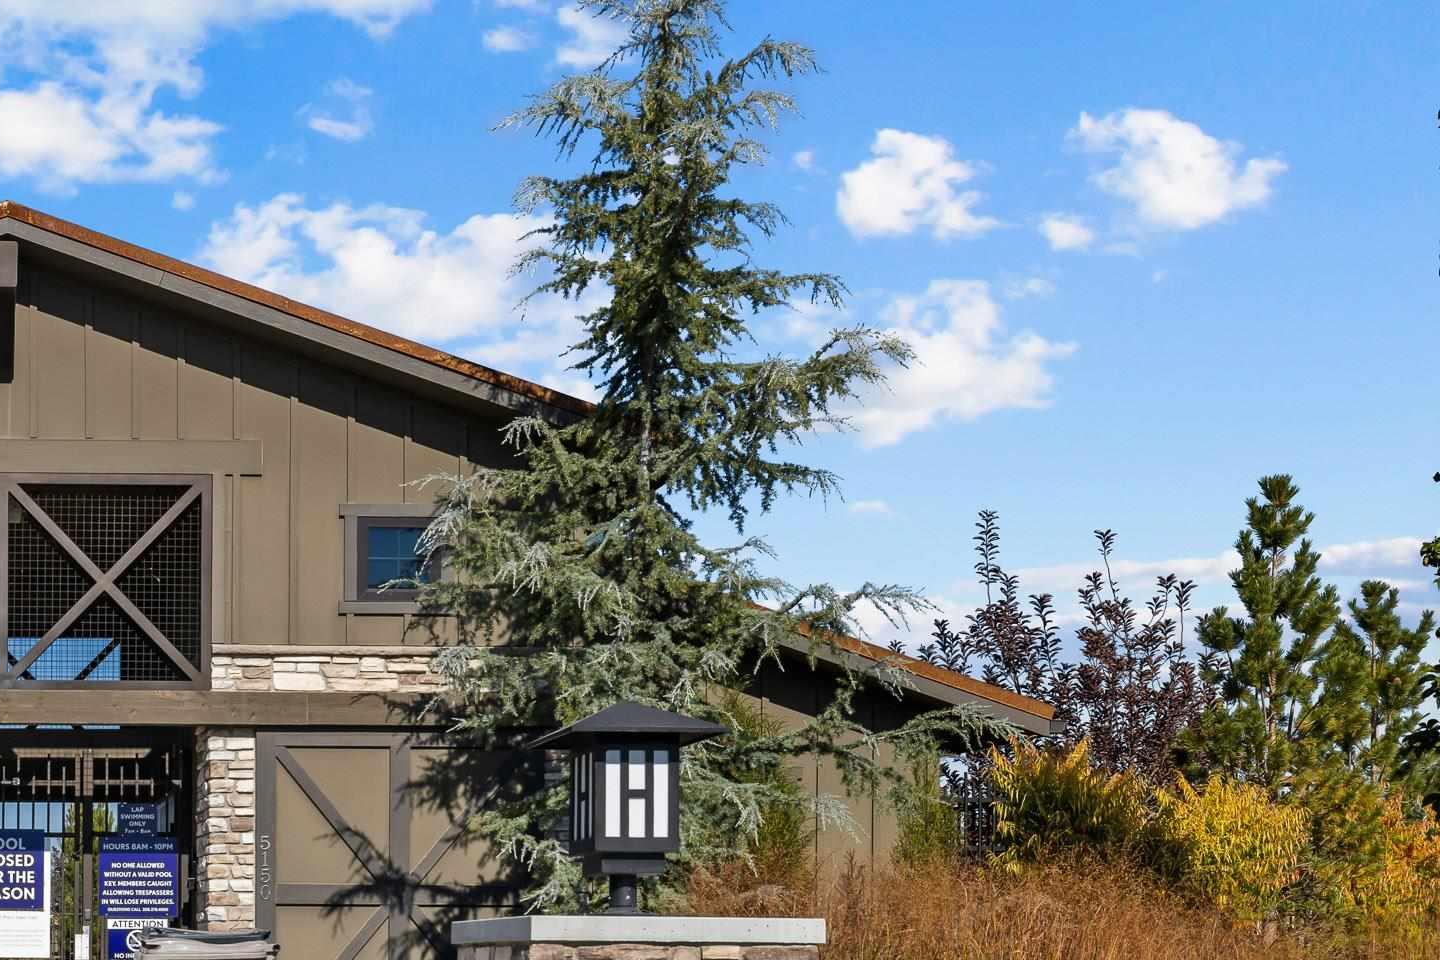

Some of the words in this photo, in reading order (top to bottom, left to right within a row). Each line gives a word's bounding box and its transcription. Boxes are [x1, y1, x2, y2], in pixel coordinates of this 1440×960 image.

[260, 835, 271, 900] 5150
[7, 870, 35, 883] THE
[112, 920, 164, 928] ATTENTION
